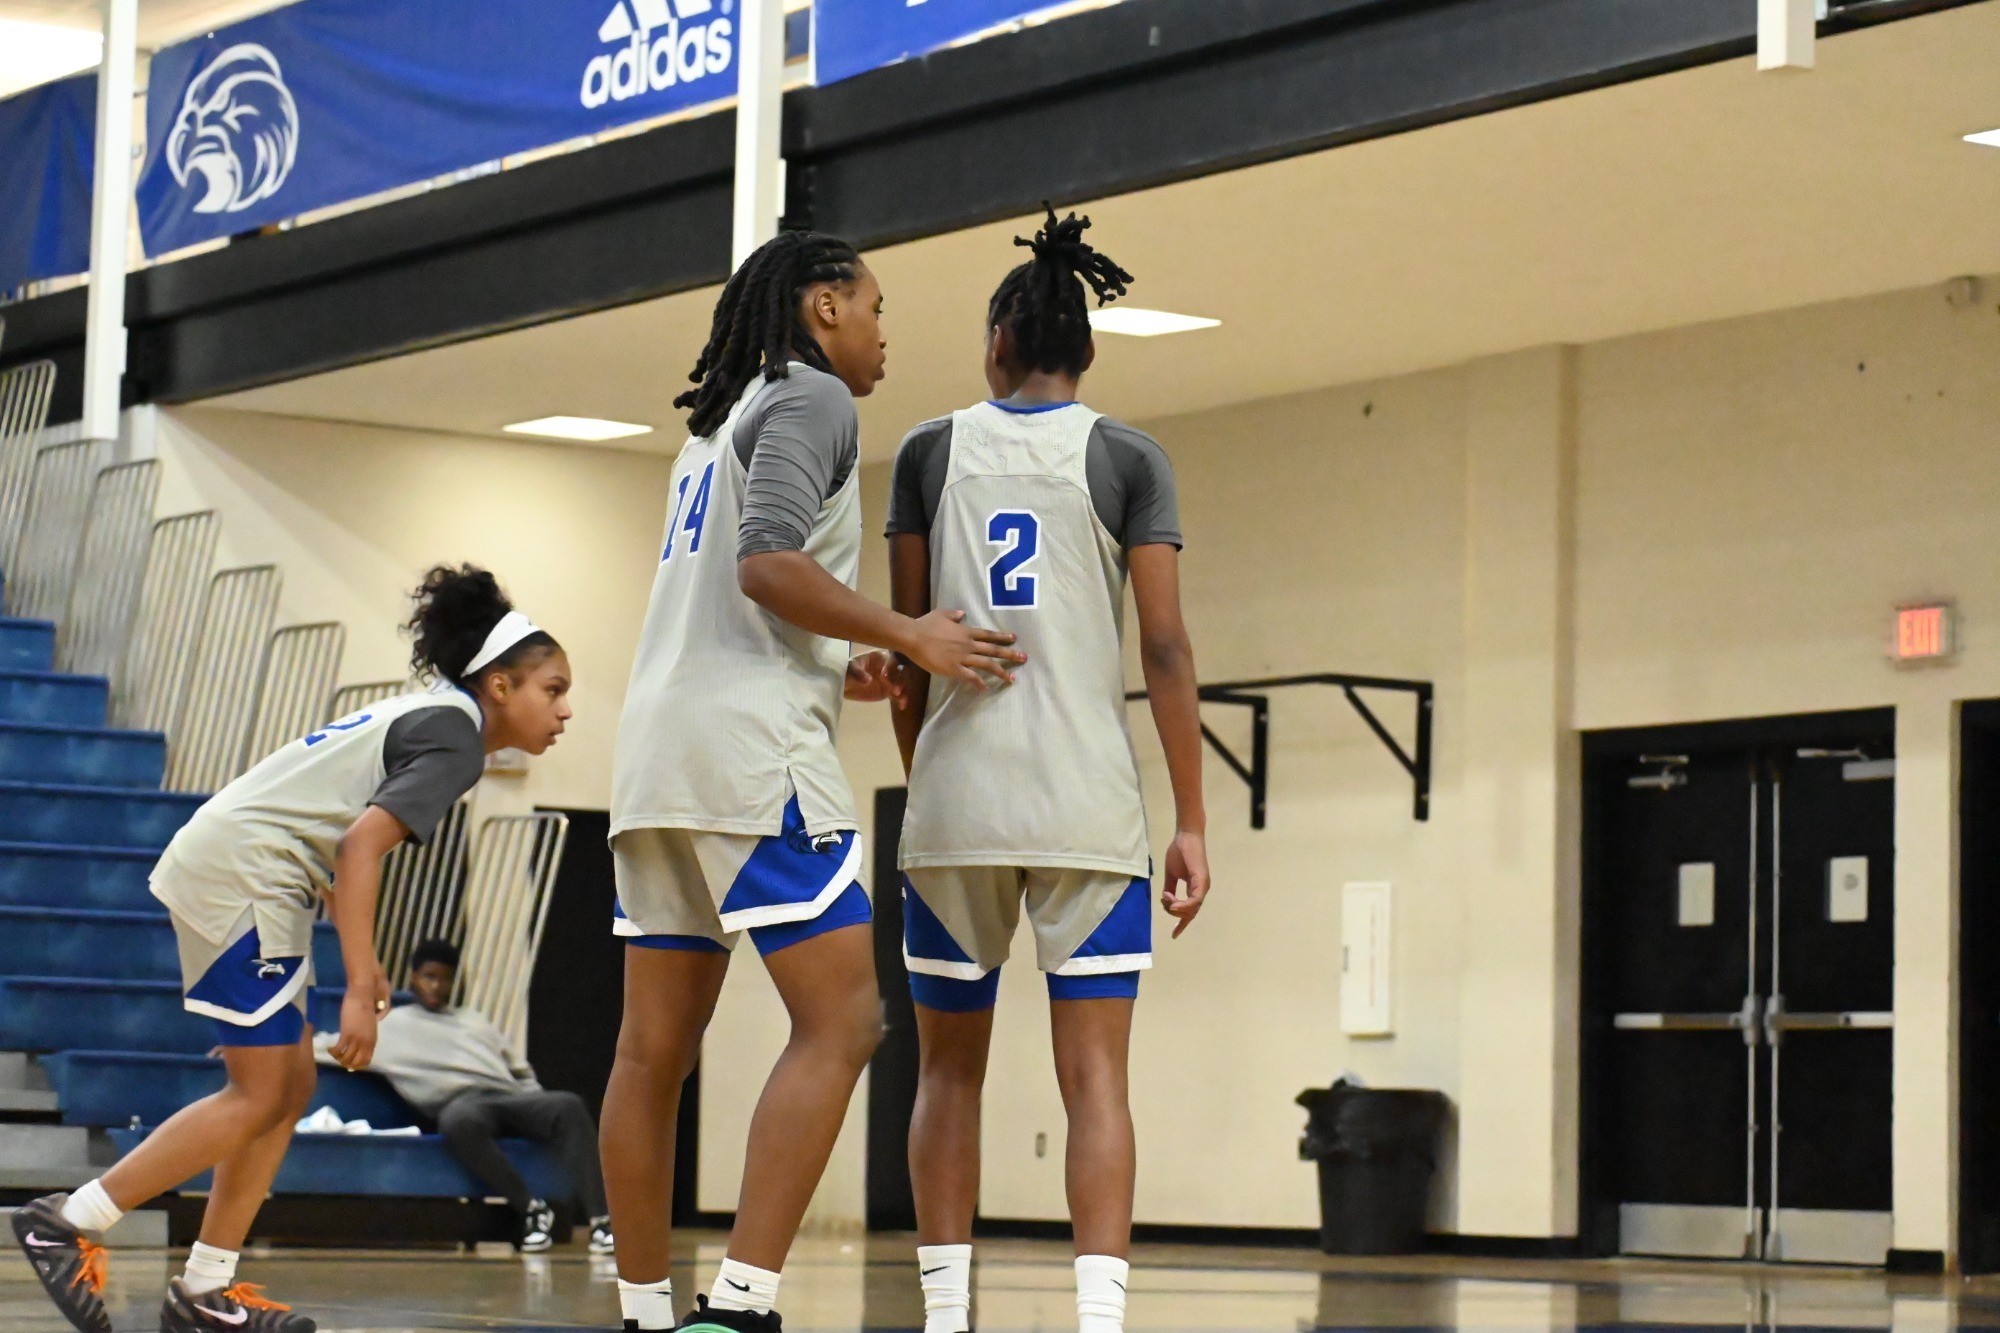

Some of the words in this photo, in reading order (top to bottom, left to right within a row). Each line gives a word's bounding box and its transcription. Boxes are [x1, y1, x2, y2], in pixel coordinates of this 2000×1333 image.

[580, 17, 733, 109] adidas
[660, 457, 717, 564] 14
[986, 509, 1041, 610] 2
